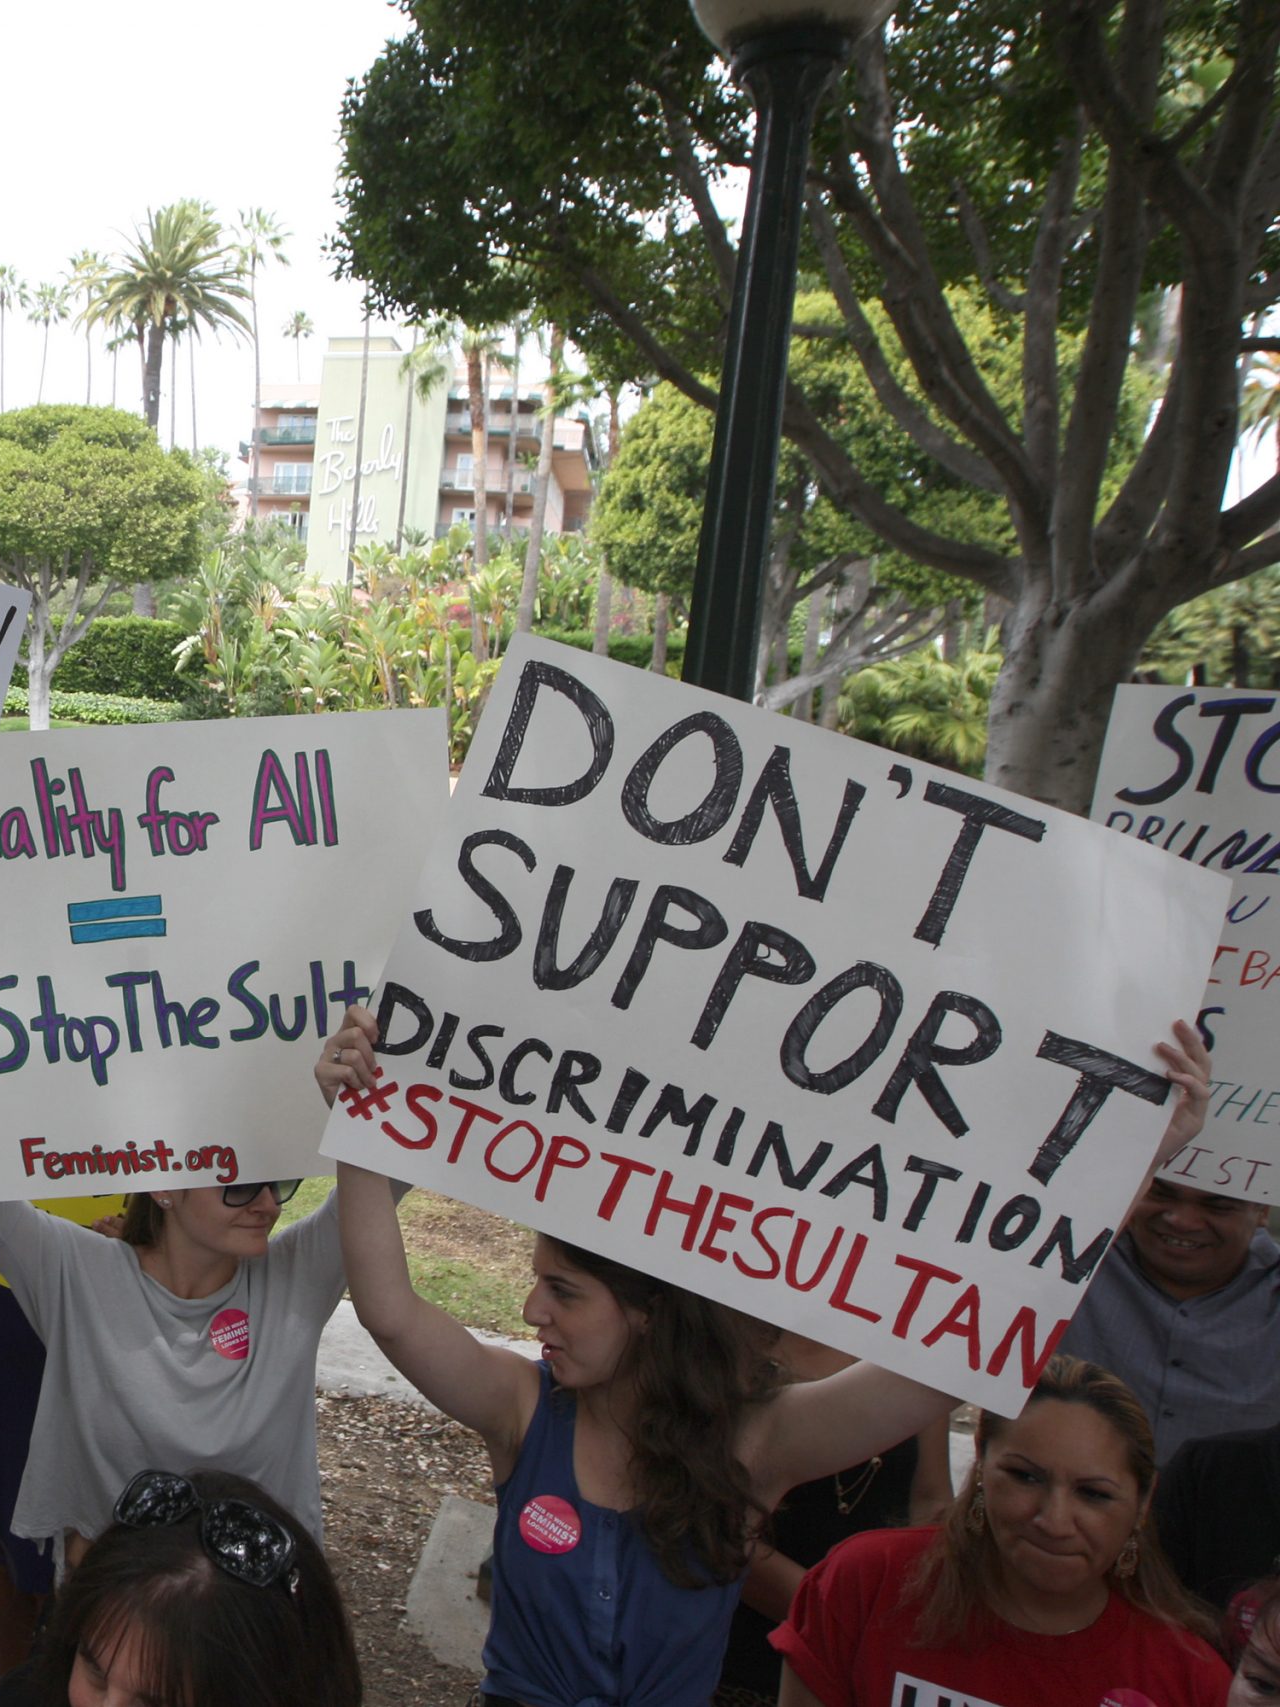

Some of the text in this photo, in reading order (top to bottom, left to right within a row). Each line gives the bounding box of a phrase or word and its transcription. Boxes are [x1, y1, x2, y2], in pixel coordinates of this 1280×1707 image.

[326, 416, 355, 442] The
[138, 766, 220, 857] for
[249, 748, 340, 851] All
[480, 660, 1047, 949] DON'T
[413, 829, 1172, 1188] SUPPORT
[20, 1136, 239, 1183] Feminist.org
[372, 981, 1114, 1286] DISCRIMINATION
[338, 1065, 1072, 1390] #STOPTHESULTAN
[212, 1325, 249, 1345] FEMINIS
[523, 1505, 577, 1544] FEMINIST
